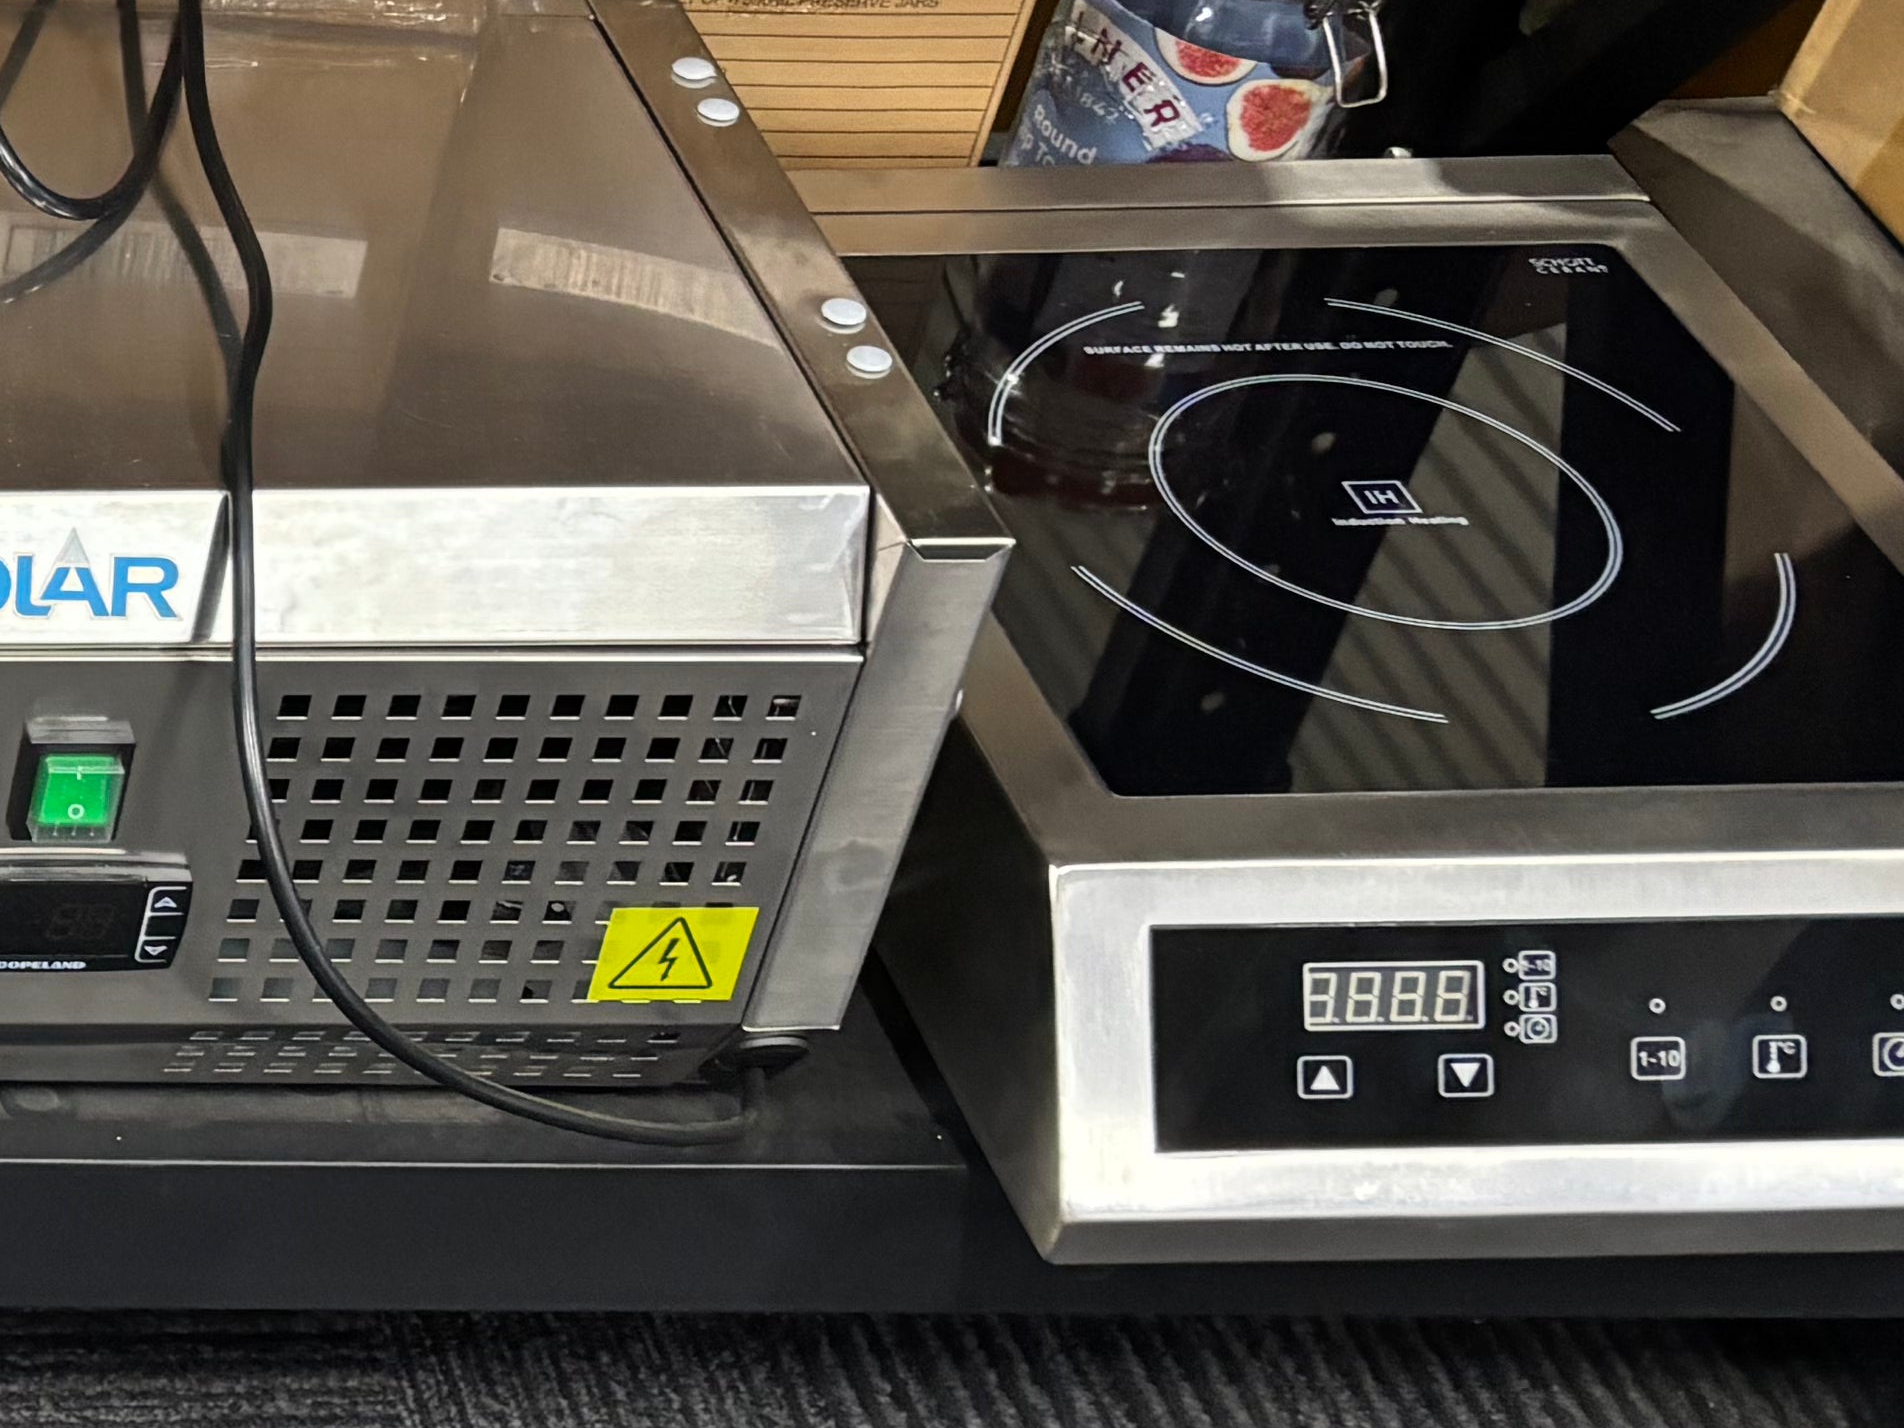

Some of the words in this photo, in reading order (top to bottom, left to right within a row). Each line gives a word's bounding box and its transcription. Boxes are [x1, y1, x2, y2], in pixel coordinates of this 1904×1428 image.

[1084, 346, 1151, 354] SURFACE
[1154, 345, 1220, 353] REMAINS
[1255, 343, 1303, 351] AFTER
[1340, 341, 1362, 350] DO
[1363, 341, 1394, 349] NOT
[1364, 490, 1400, 504] IH
[1331, 517, 1406, 526] Induction
[1408, 517, 1469, 525] Heating
[1639, 1049, 1681, 1067] 1-10
